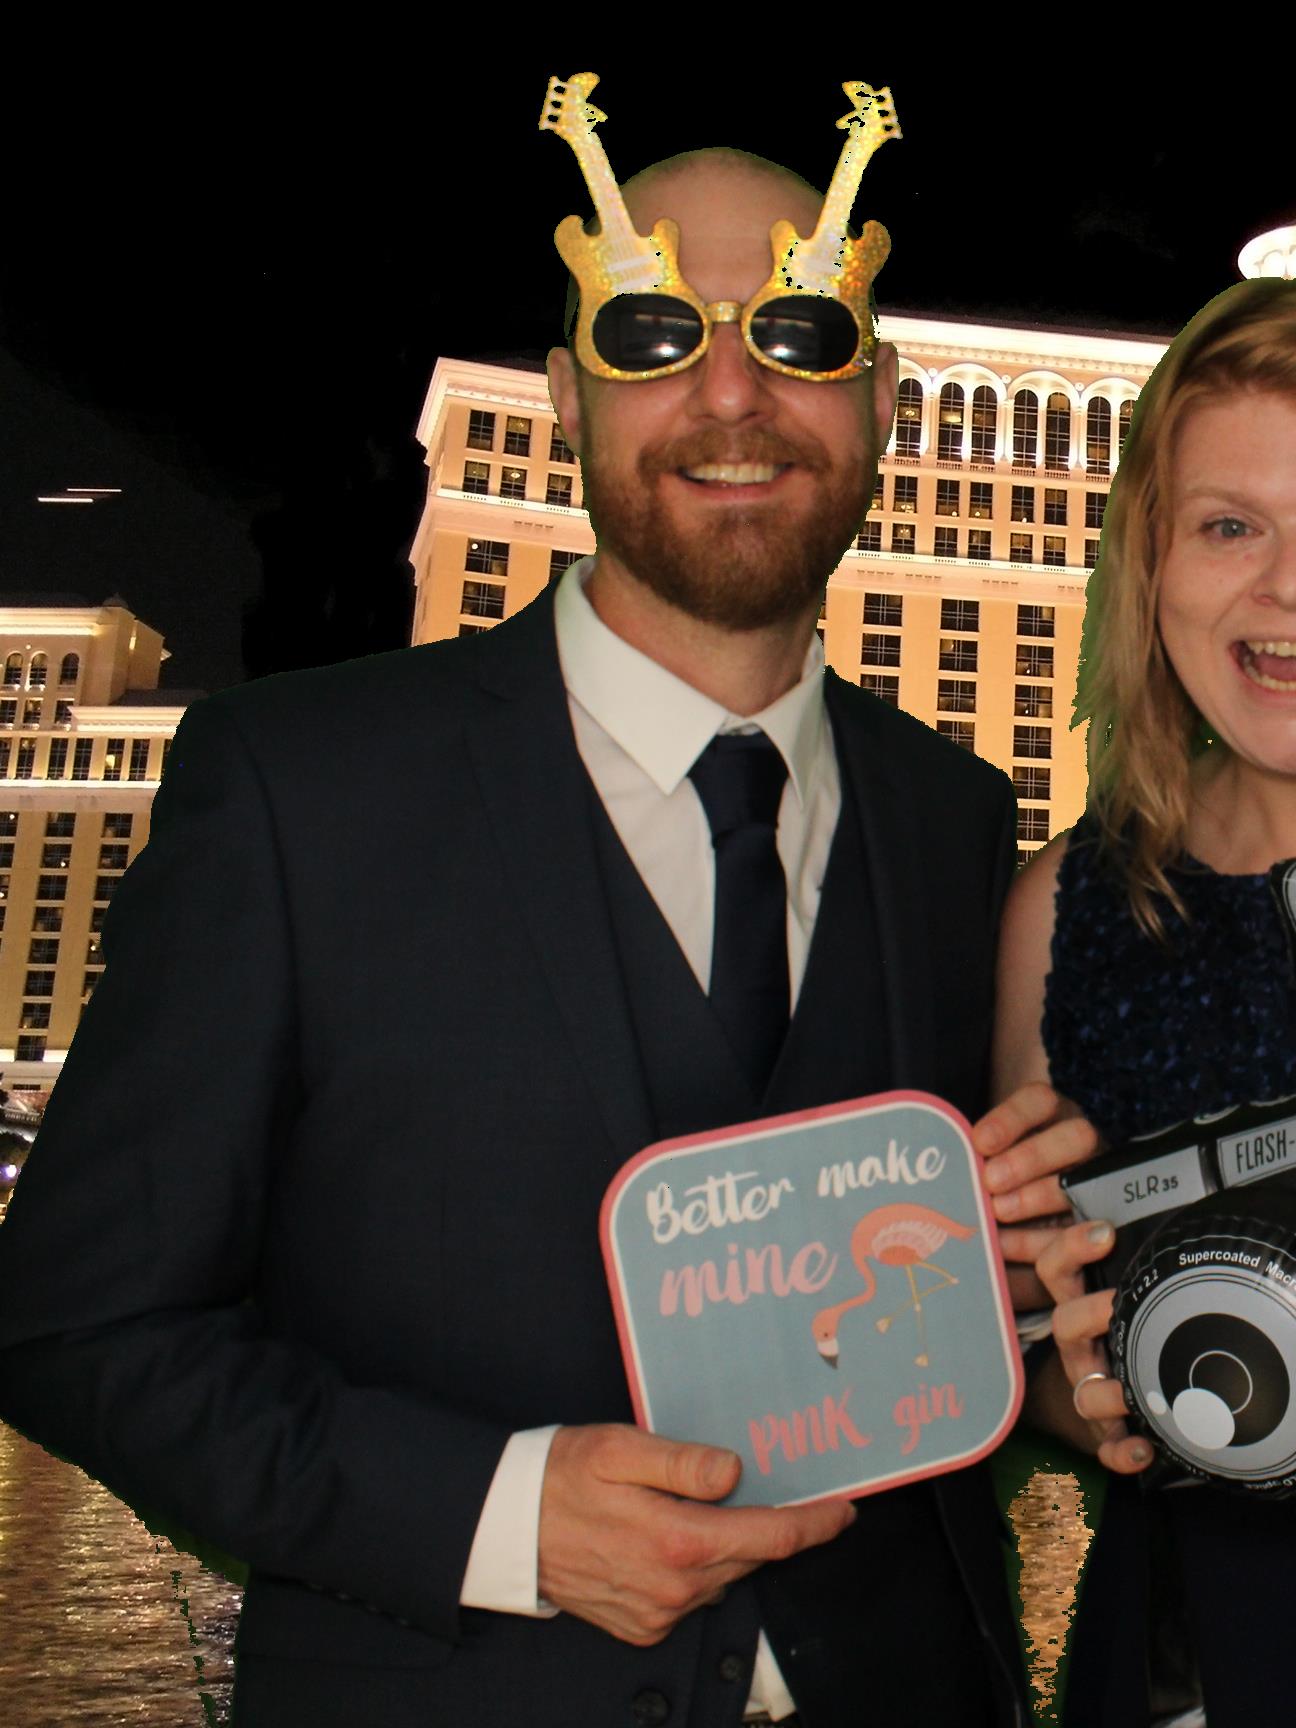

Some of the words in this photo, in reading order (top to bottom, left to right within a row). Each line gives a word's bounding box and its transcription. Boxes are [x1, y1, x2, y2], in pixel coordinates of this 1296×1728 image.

[645, 1170, 795, 1245] Better
[817, 1139, 947, 1199] make
[1123, 1175, 1160, 1204] SLR
[1162, 1176, 1179, 1192] 35
[658, 1241, 838, 1319] mine
[1178, 1249, 1261, 1268] Supercoated
[892, 1382, 965, 1455] gin
